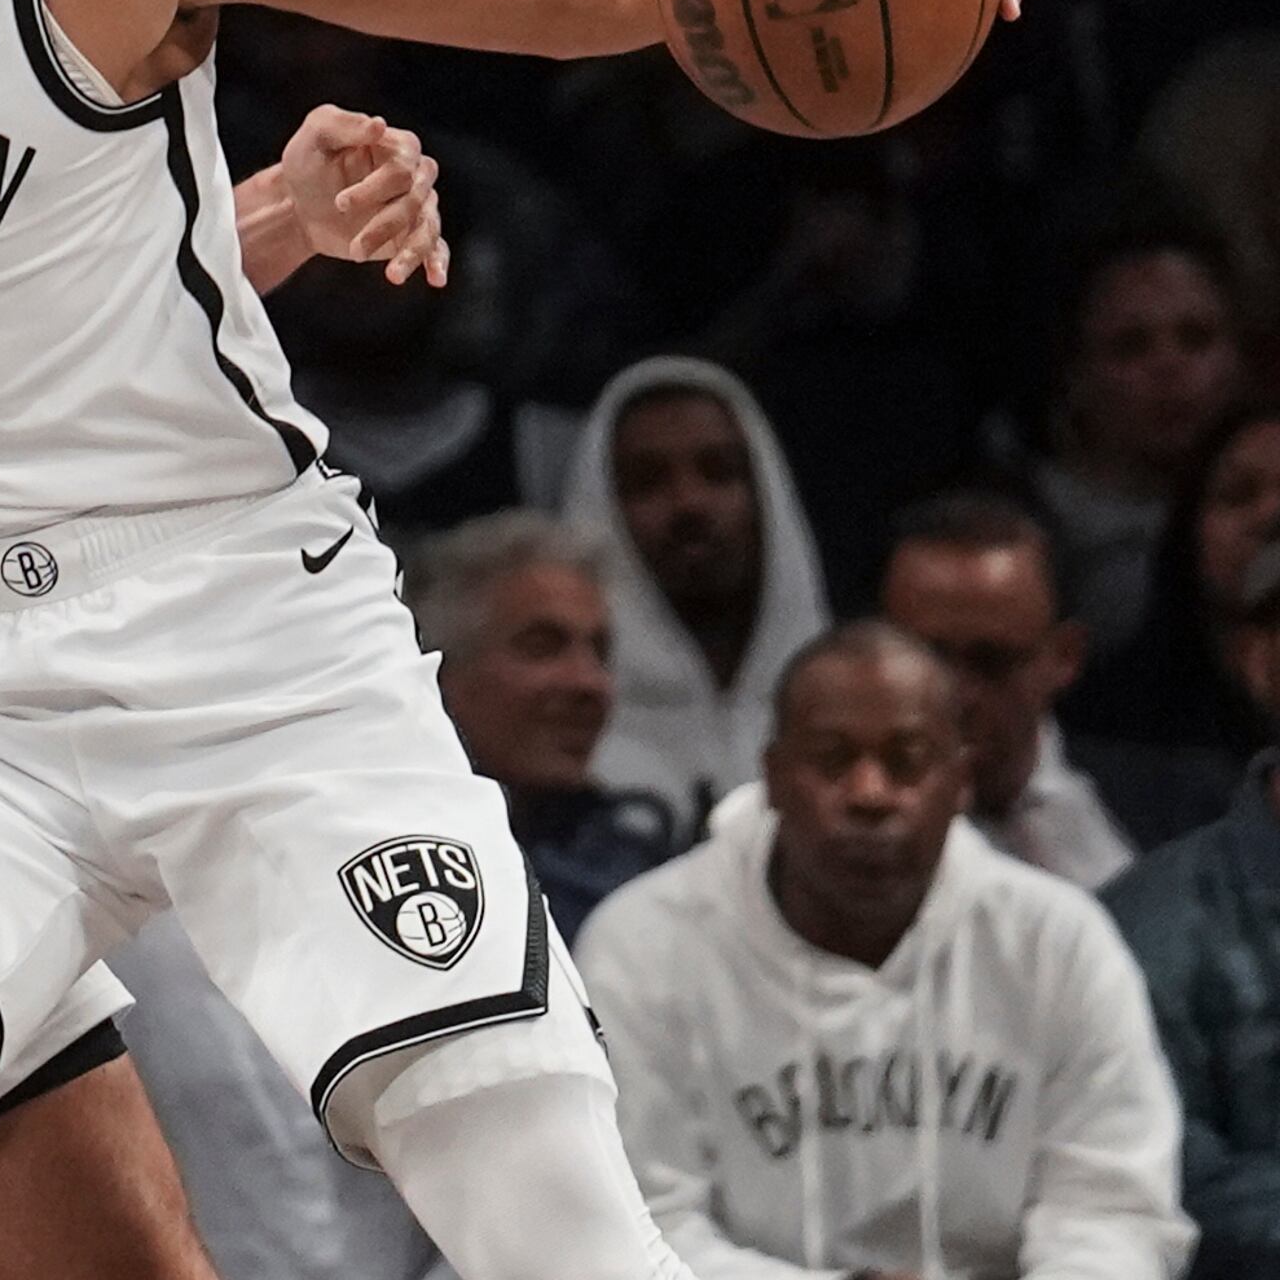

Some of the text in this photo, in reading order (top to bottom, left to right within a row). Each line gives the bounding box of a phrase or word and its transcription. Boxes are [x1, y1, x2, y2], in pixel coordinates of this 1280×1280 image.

[17, 551, 43, 590] B
[352, 843, 477, 913] NETS
[416, 901, 447, 947] B
